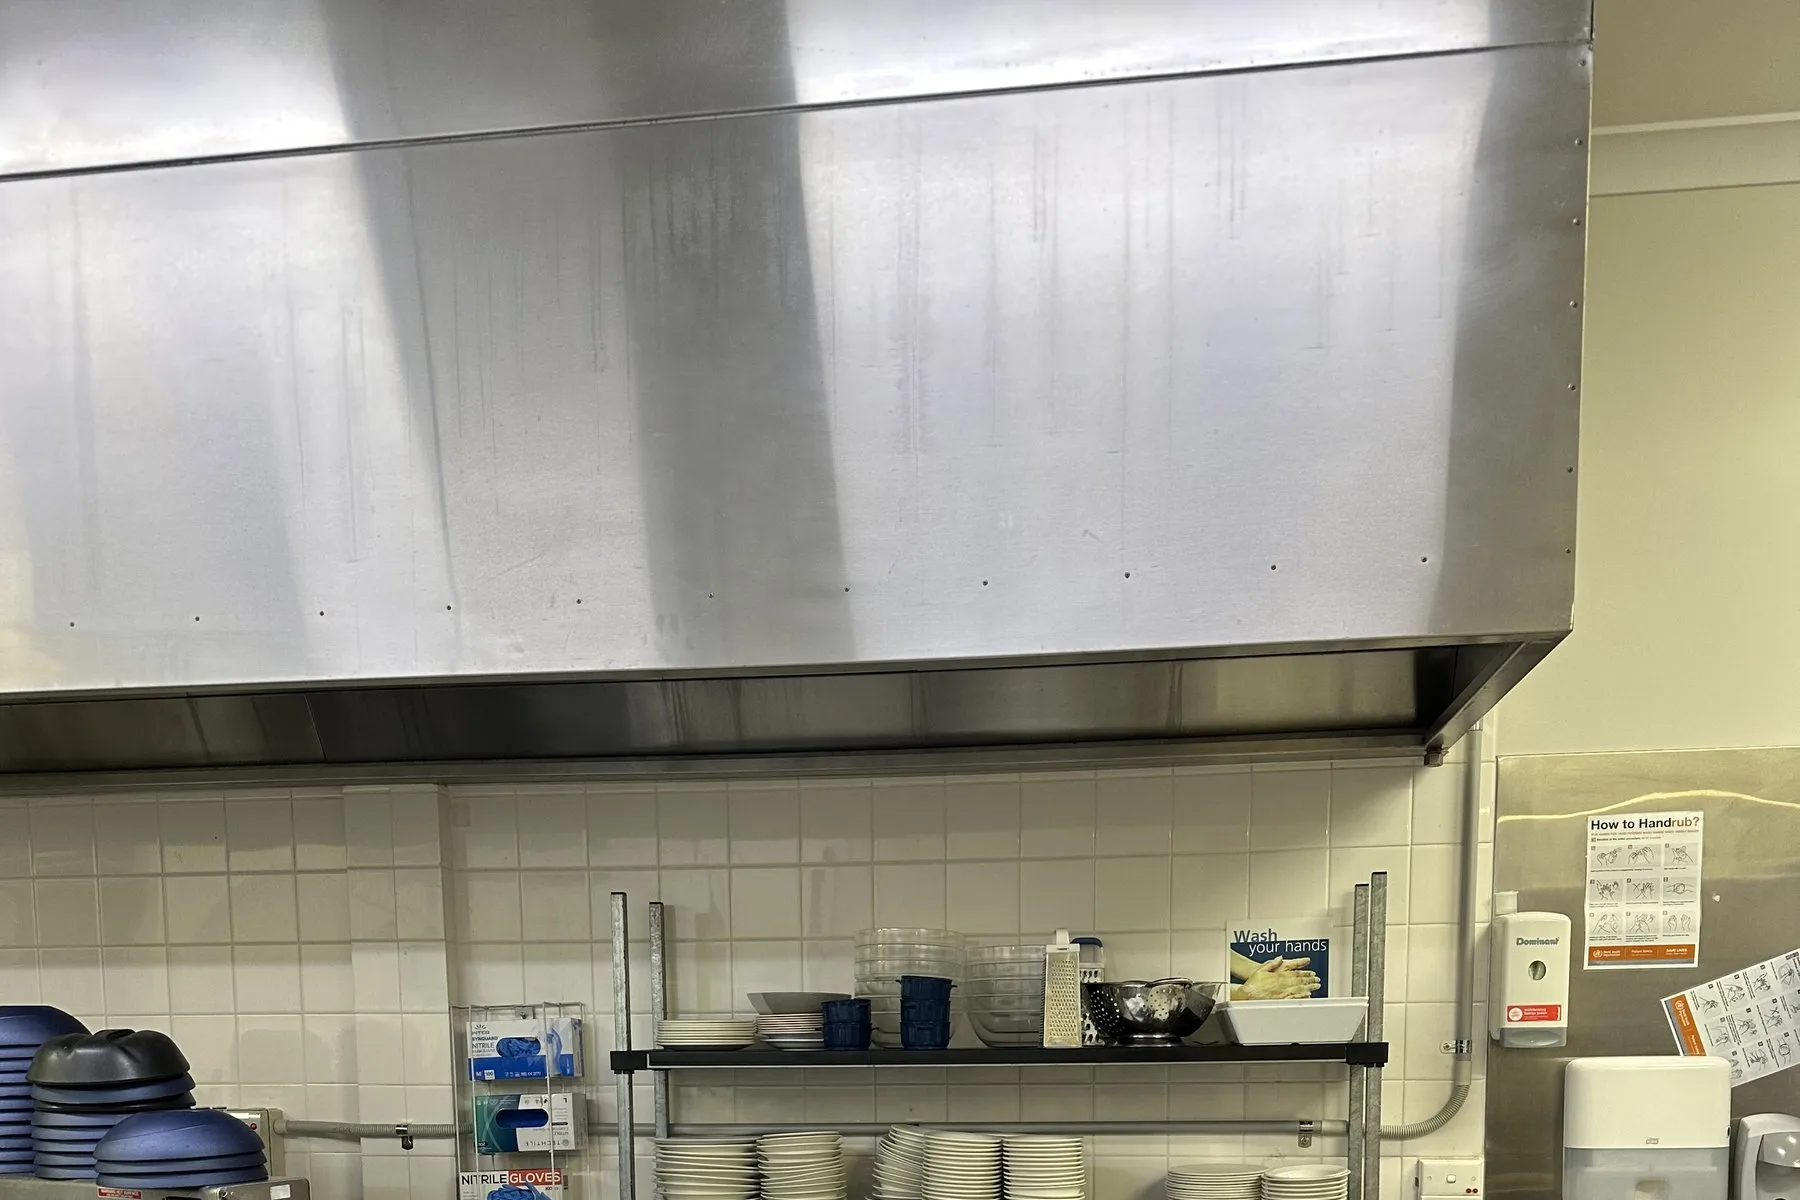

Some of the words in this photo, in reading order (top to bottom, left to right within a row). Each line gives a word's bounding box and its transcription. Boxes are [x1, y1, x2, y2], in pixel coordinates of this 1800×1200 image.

[1591, 819, 1619, 830] How
[1623, 819, 1635, 829] to
[1639, 816, 1700, 829] Handrub?
[1233, 928, 1277, 942] Wash
[1516, 937, 1559, 946] Dominant
[1248, 942, 1280, 957] your
[1285, 940, 1327, 952] hands
[461, 1174, 507, 1185] NITRILE
[509, 1172, 560, 1184] GLOVES
